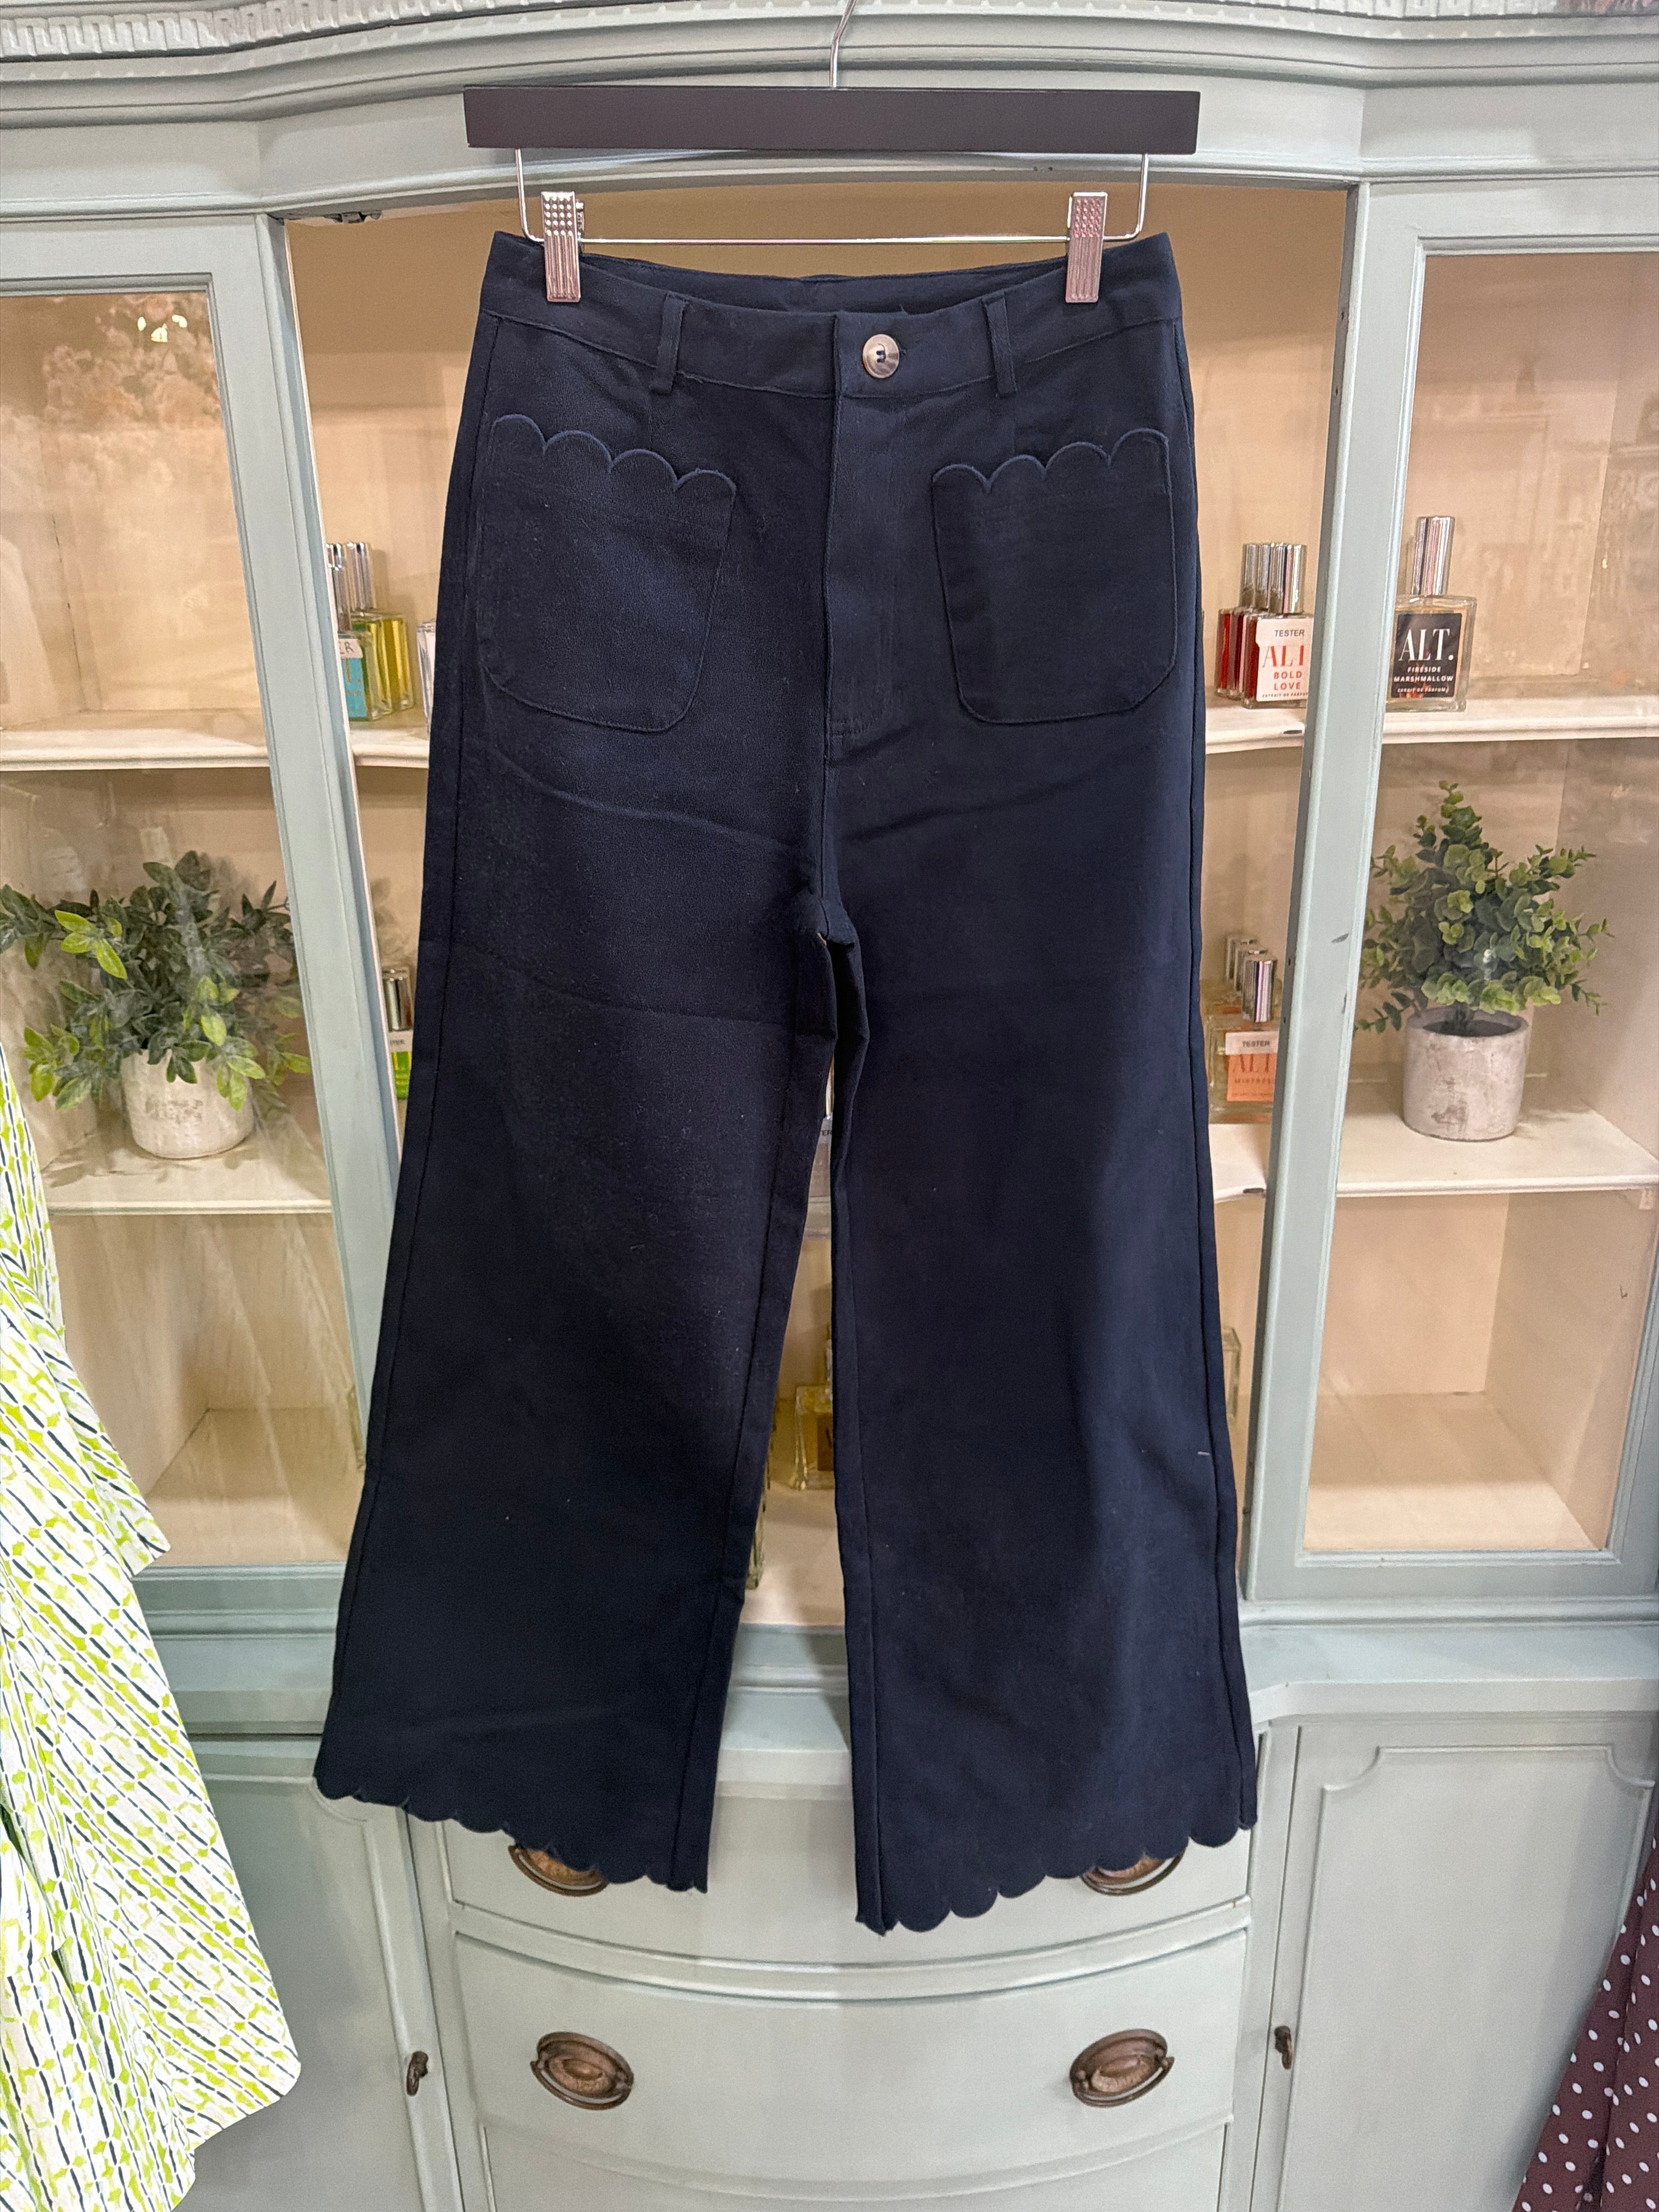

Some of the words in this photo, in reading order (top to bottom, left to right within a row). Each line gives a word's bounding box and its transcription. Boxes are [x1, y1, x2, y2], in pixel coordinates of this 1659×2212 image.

[1398, 629, 1454, 661] ALT.
[1274, 671, 1302, 679] BOLD
[1274, 682, 1301, 690] LOVE
